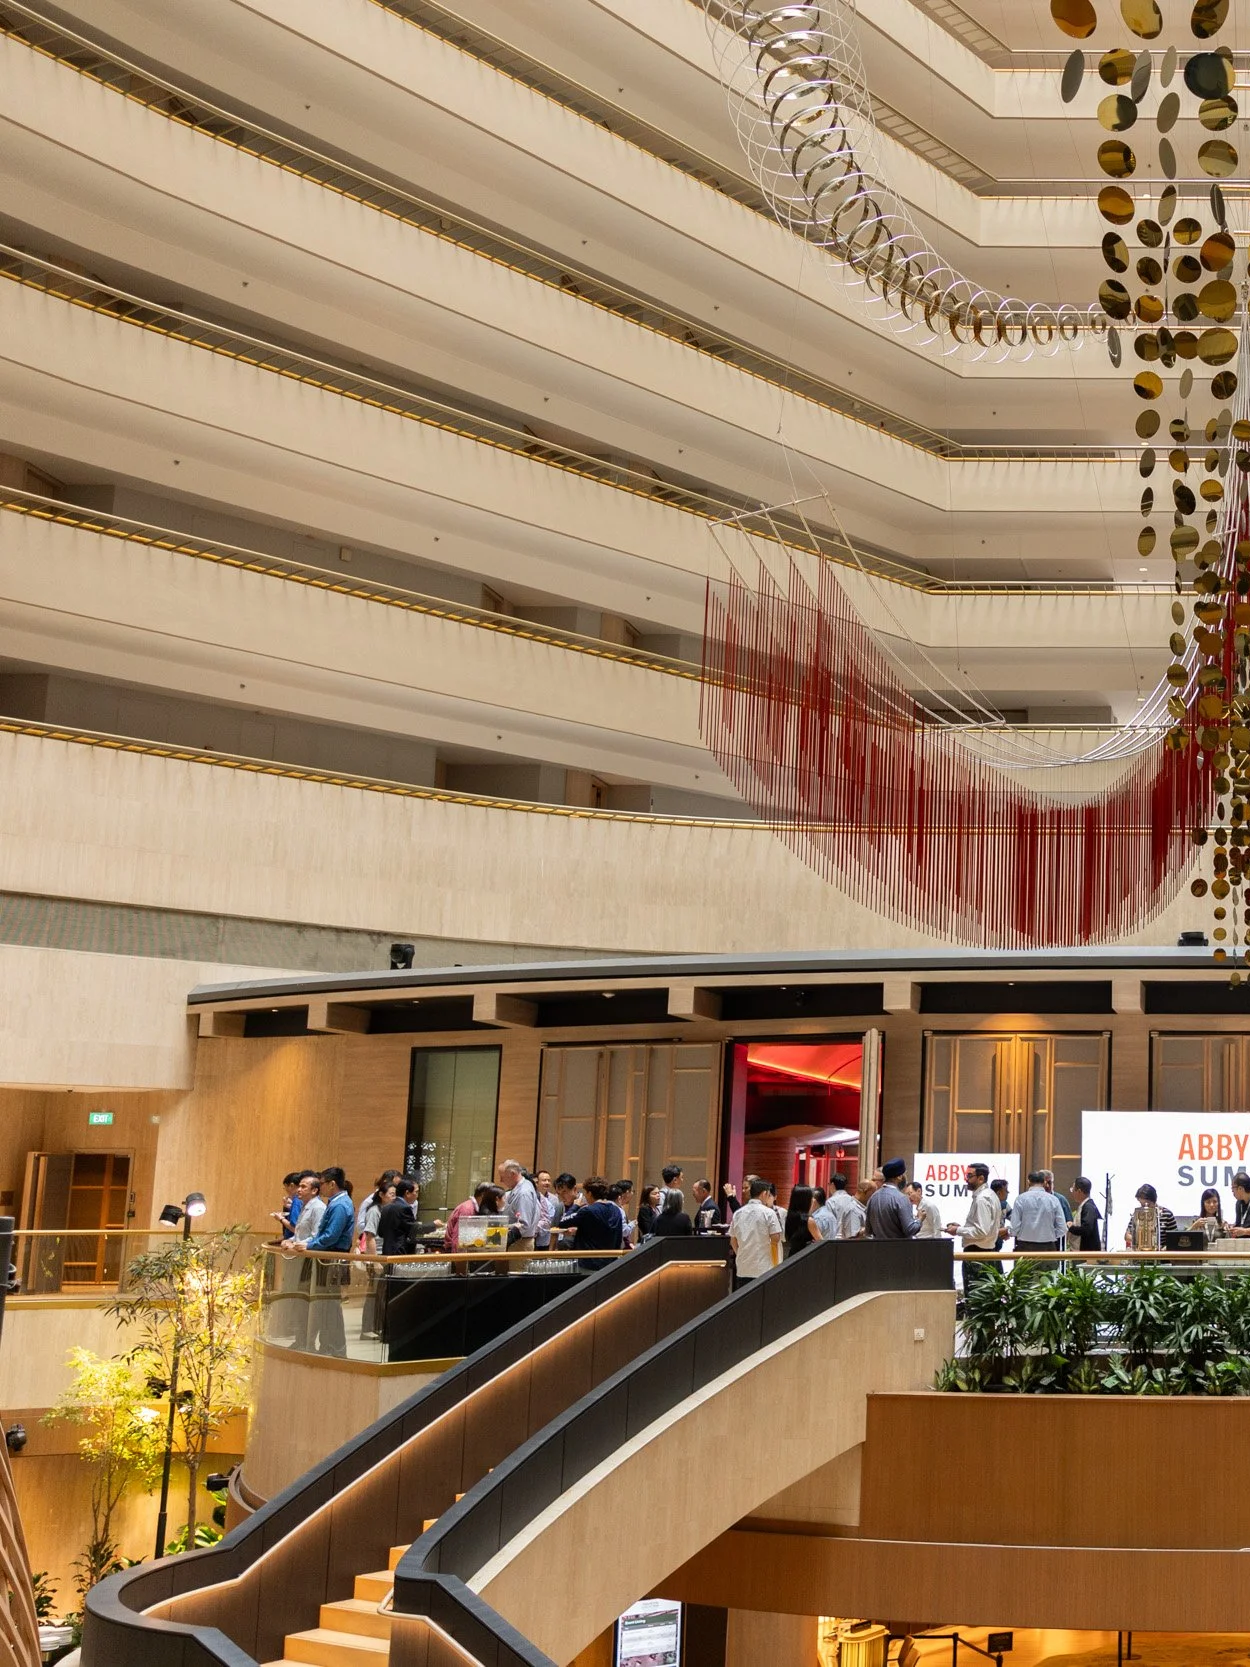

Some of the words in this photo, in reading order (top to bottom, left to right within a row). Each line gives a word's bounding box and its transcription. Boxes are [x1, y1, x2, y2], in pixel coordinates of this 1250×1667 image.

[93, 1114, 109, 1123] EXIT
[925, 1164, 969, 1181] ABBY
[925, 1183, 967, 1197] SUM
